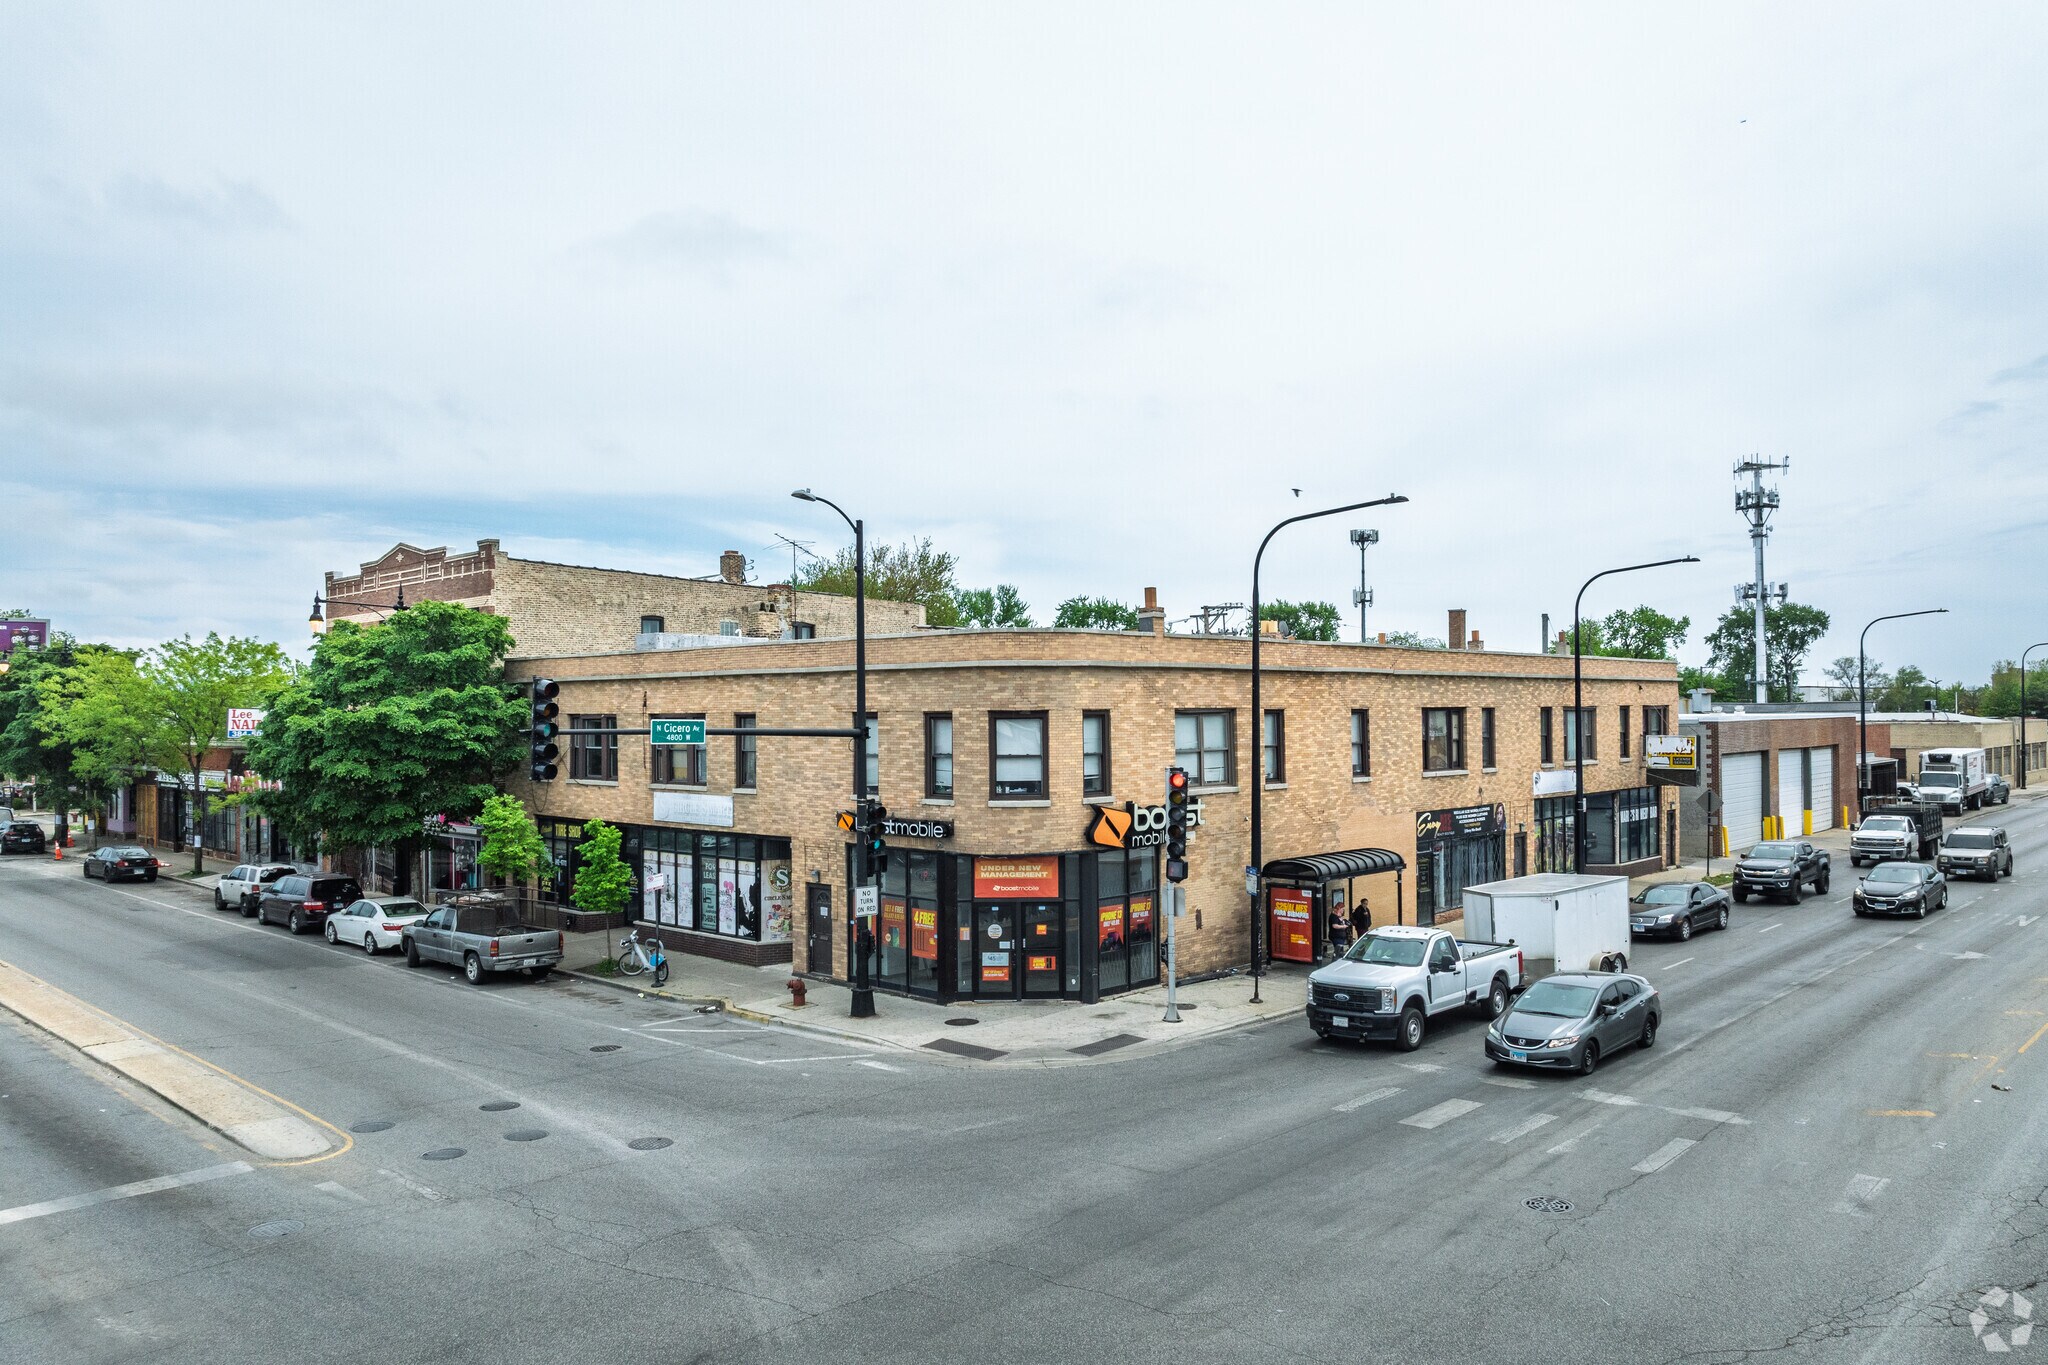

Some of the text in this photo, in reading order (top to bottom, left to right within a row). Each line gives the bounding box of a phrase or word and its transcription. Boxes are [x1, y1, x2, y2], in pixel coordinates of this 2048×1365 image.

[231, 709, 253, 719] Lee
[231, 719, 262, 730] NAI
[656, 724, 662, 732] N
[664, 722, 691, 733] Cicero
[1133, 798, 1206, 832] bost
[705, 862, 716, 870] FOR
[703, 871, 716, 880] LEAS
[894, 905, 904, 913] FREE
[913, 910, 919, 923] 4
[919, 911, 935, 926] FREE
